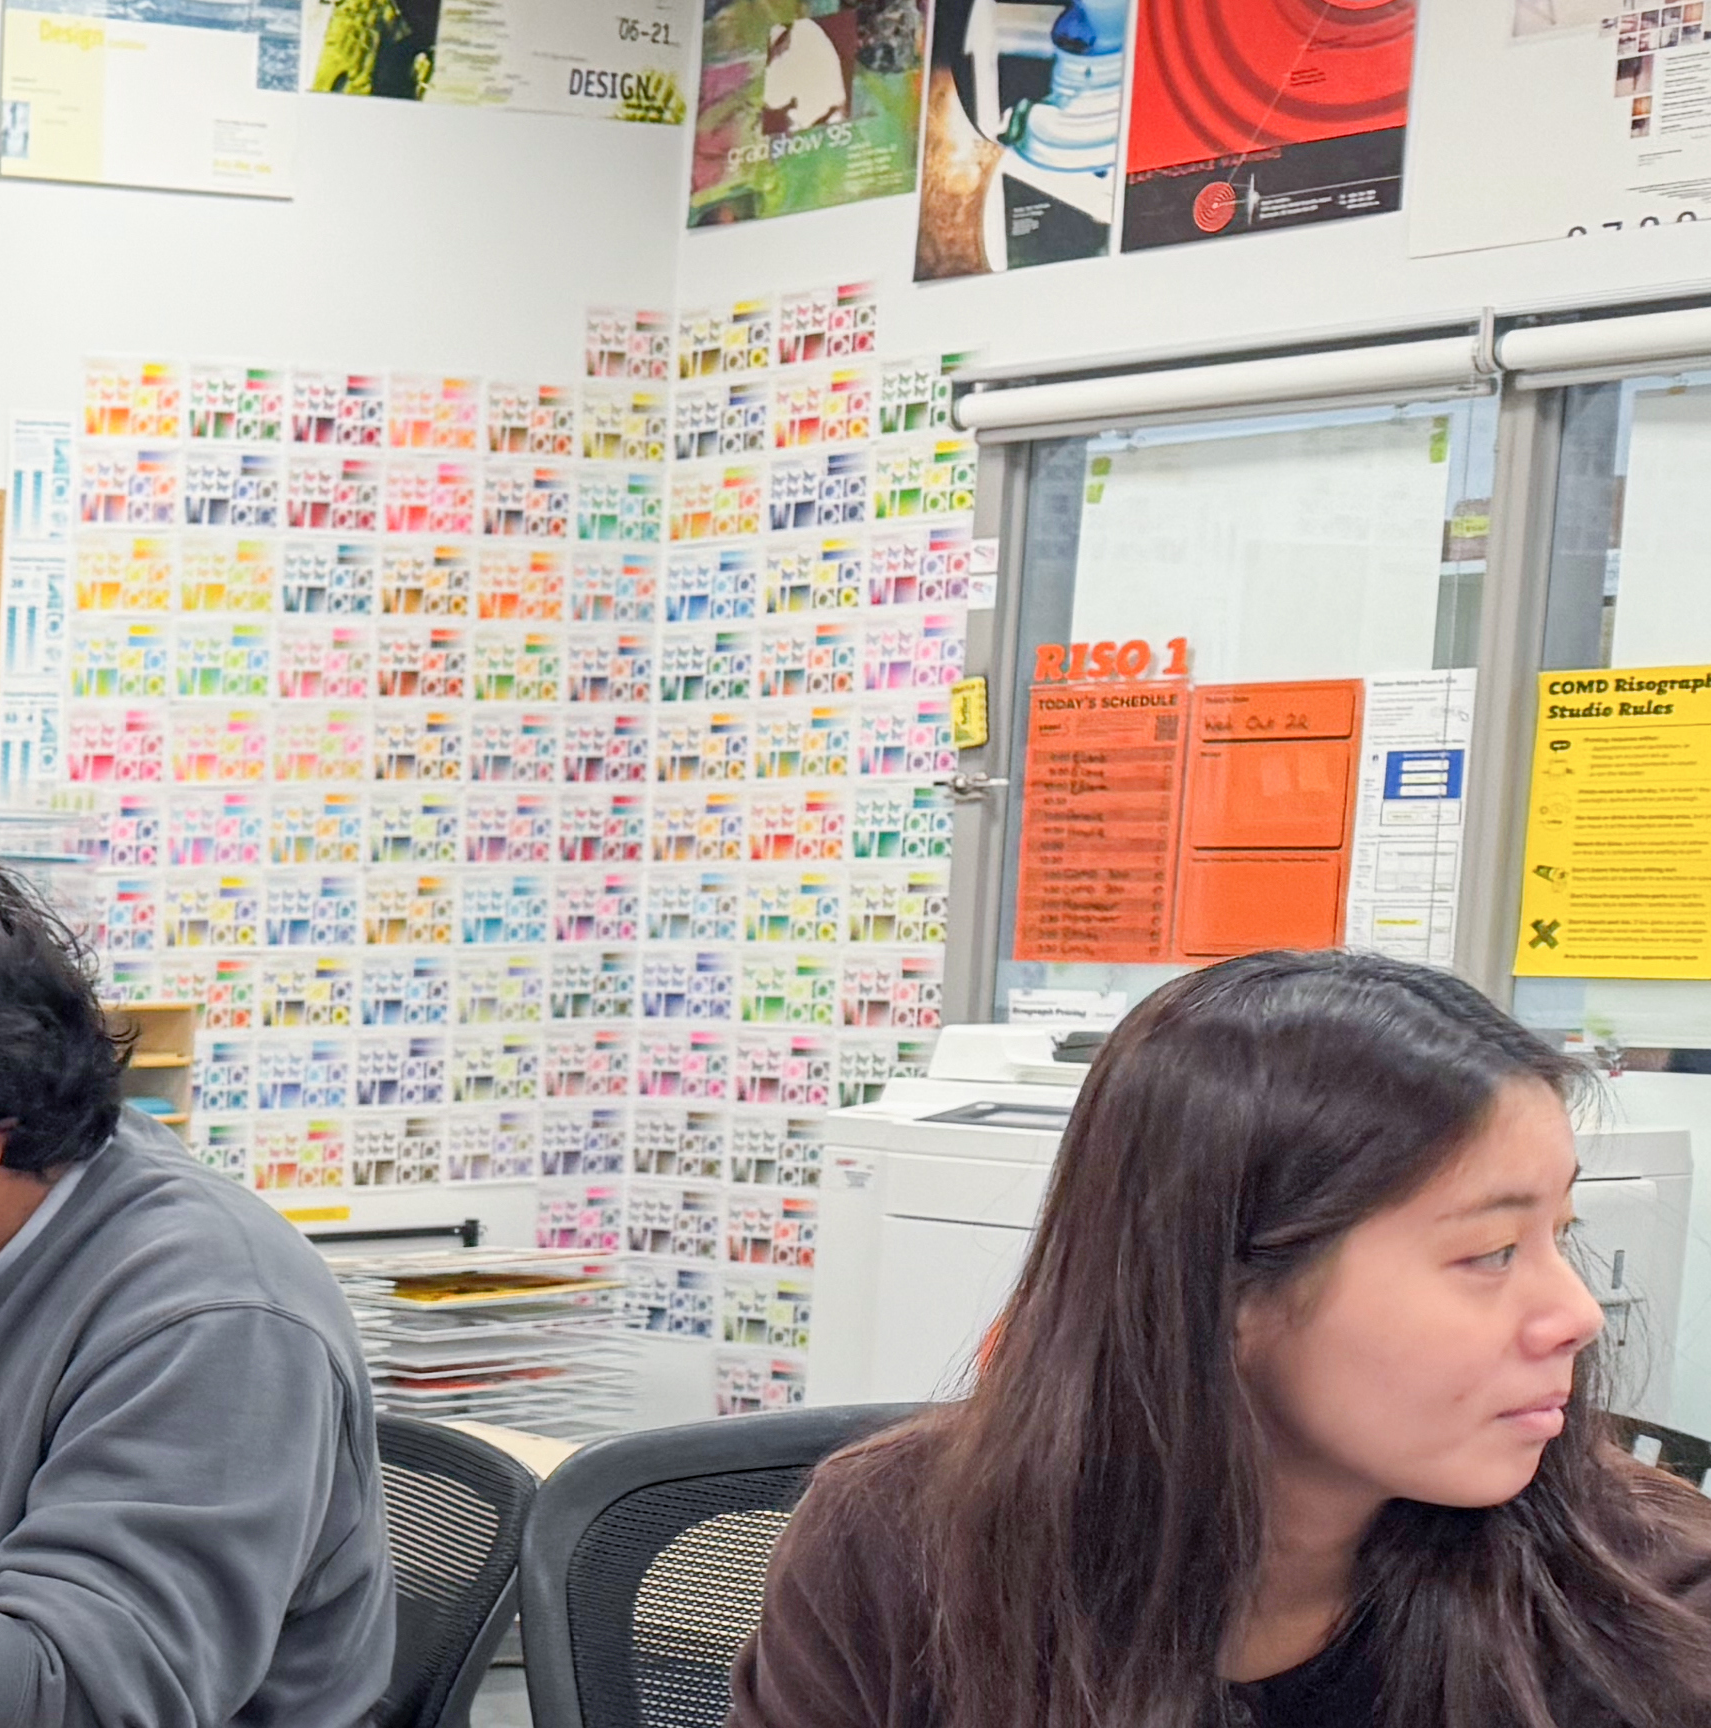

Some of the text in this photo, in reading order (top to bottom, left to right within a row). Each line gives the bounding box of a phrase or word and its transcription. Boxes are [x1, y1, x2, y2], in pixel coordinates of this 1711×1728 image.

[728, 139, 771, 172] grad
[772, 130, 824, 160] show
[1034, 637, 1190, 682] RISO 1
[1548, 680, 1608, 696] COMD
[1038, 693, 1178, 711] TODAY'S SCHEDULE
[1547, 700, 1675, 720] Studio Rules
